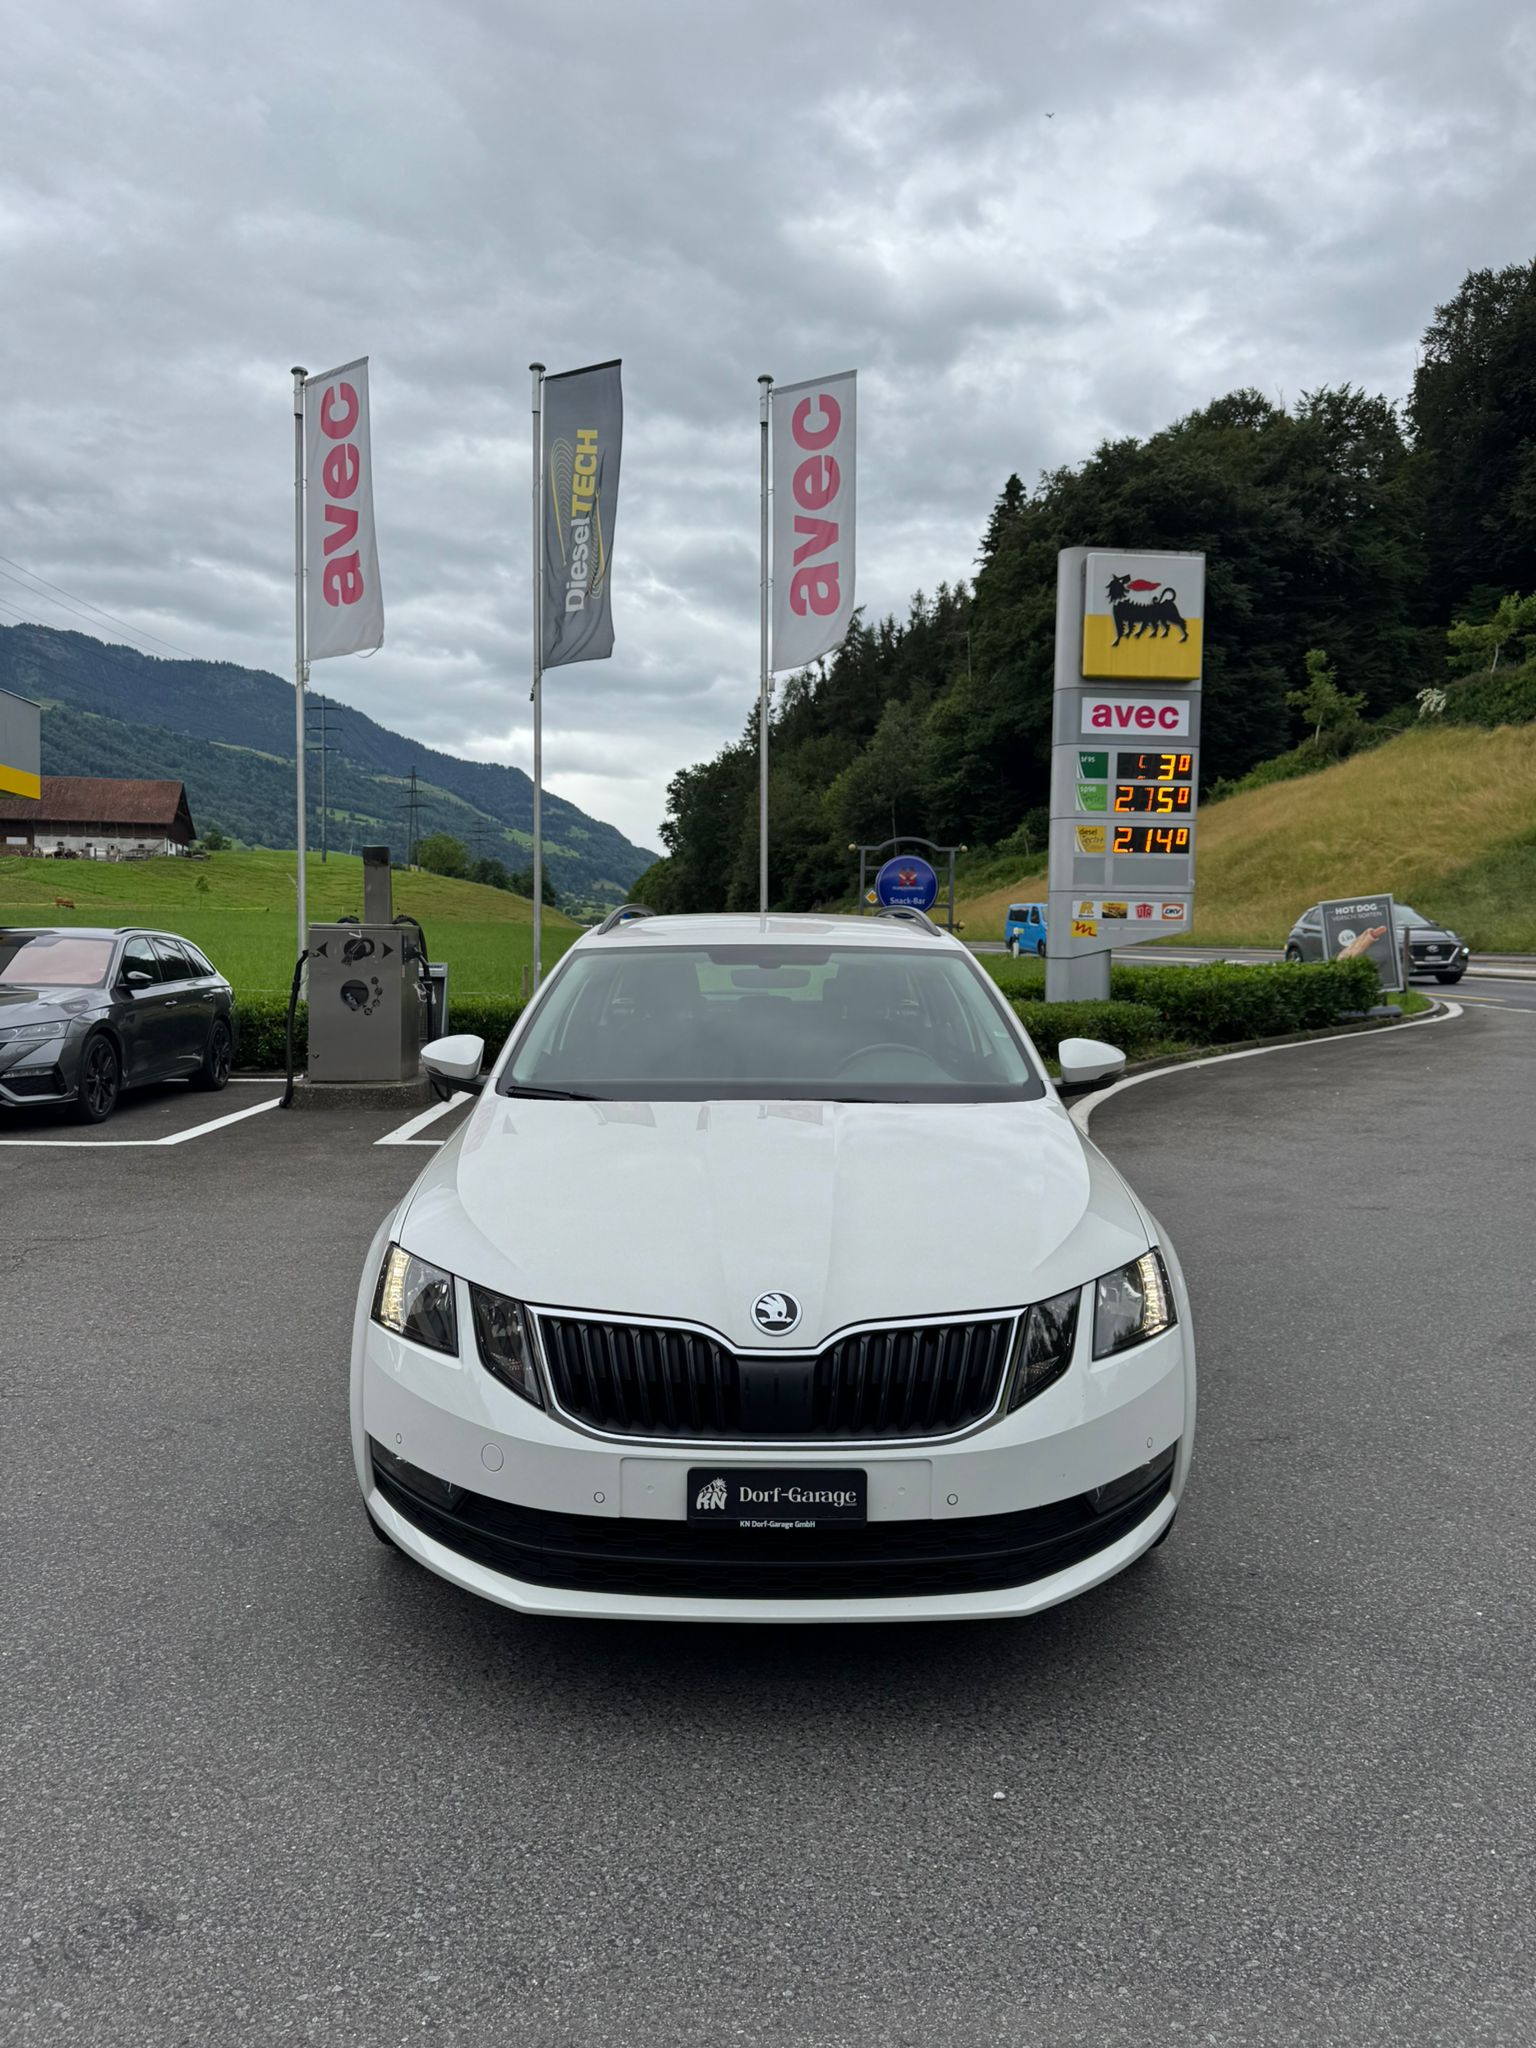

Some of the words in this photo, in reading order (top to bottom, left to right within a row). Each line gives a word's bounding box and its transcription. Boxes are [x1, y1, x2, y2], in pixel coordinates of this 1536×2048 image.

[321, 381, 364, 607] avec
[790, 393, 841, 616] avec
[565, 428, 599, 613] DieselTECH
[1091, 704, 1179, 729] avec
[889, 896, 926, 905] Snack-Bar
[1335, 906, 1354, 915] HOT
[1357, 903, 1378, 912] DOG
[696, 1491, 728, 1511] KN
[739, 1486, 857, 1507] Dorf-Garage
[740, 1520, 751, 1528] KN
[752, 1520, 794, 1529] Dorf-Garage
[795, 1520, 815, 1528] GmbH
